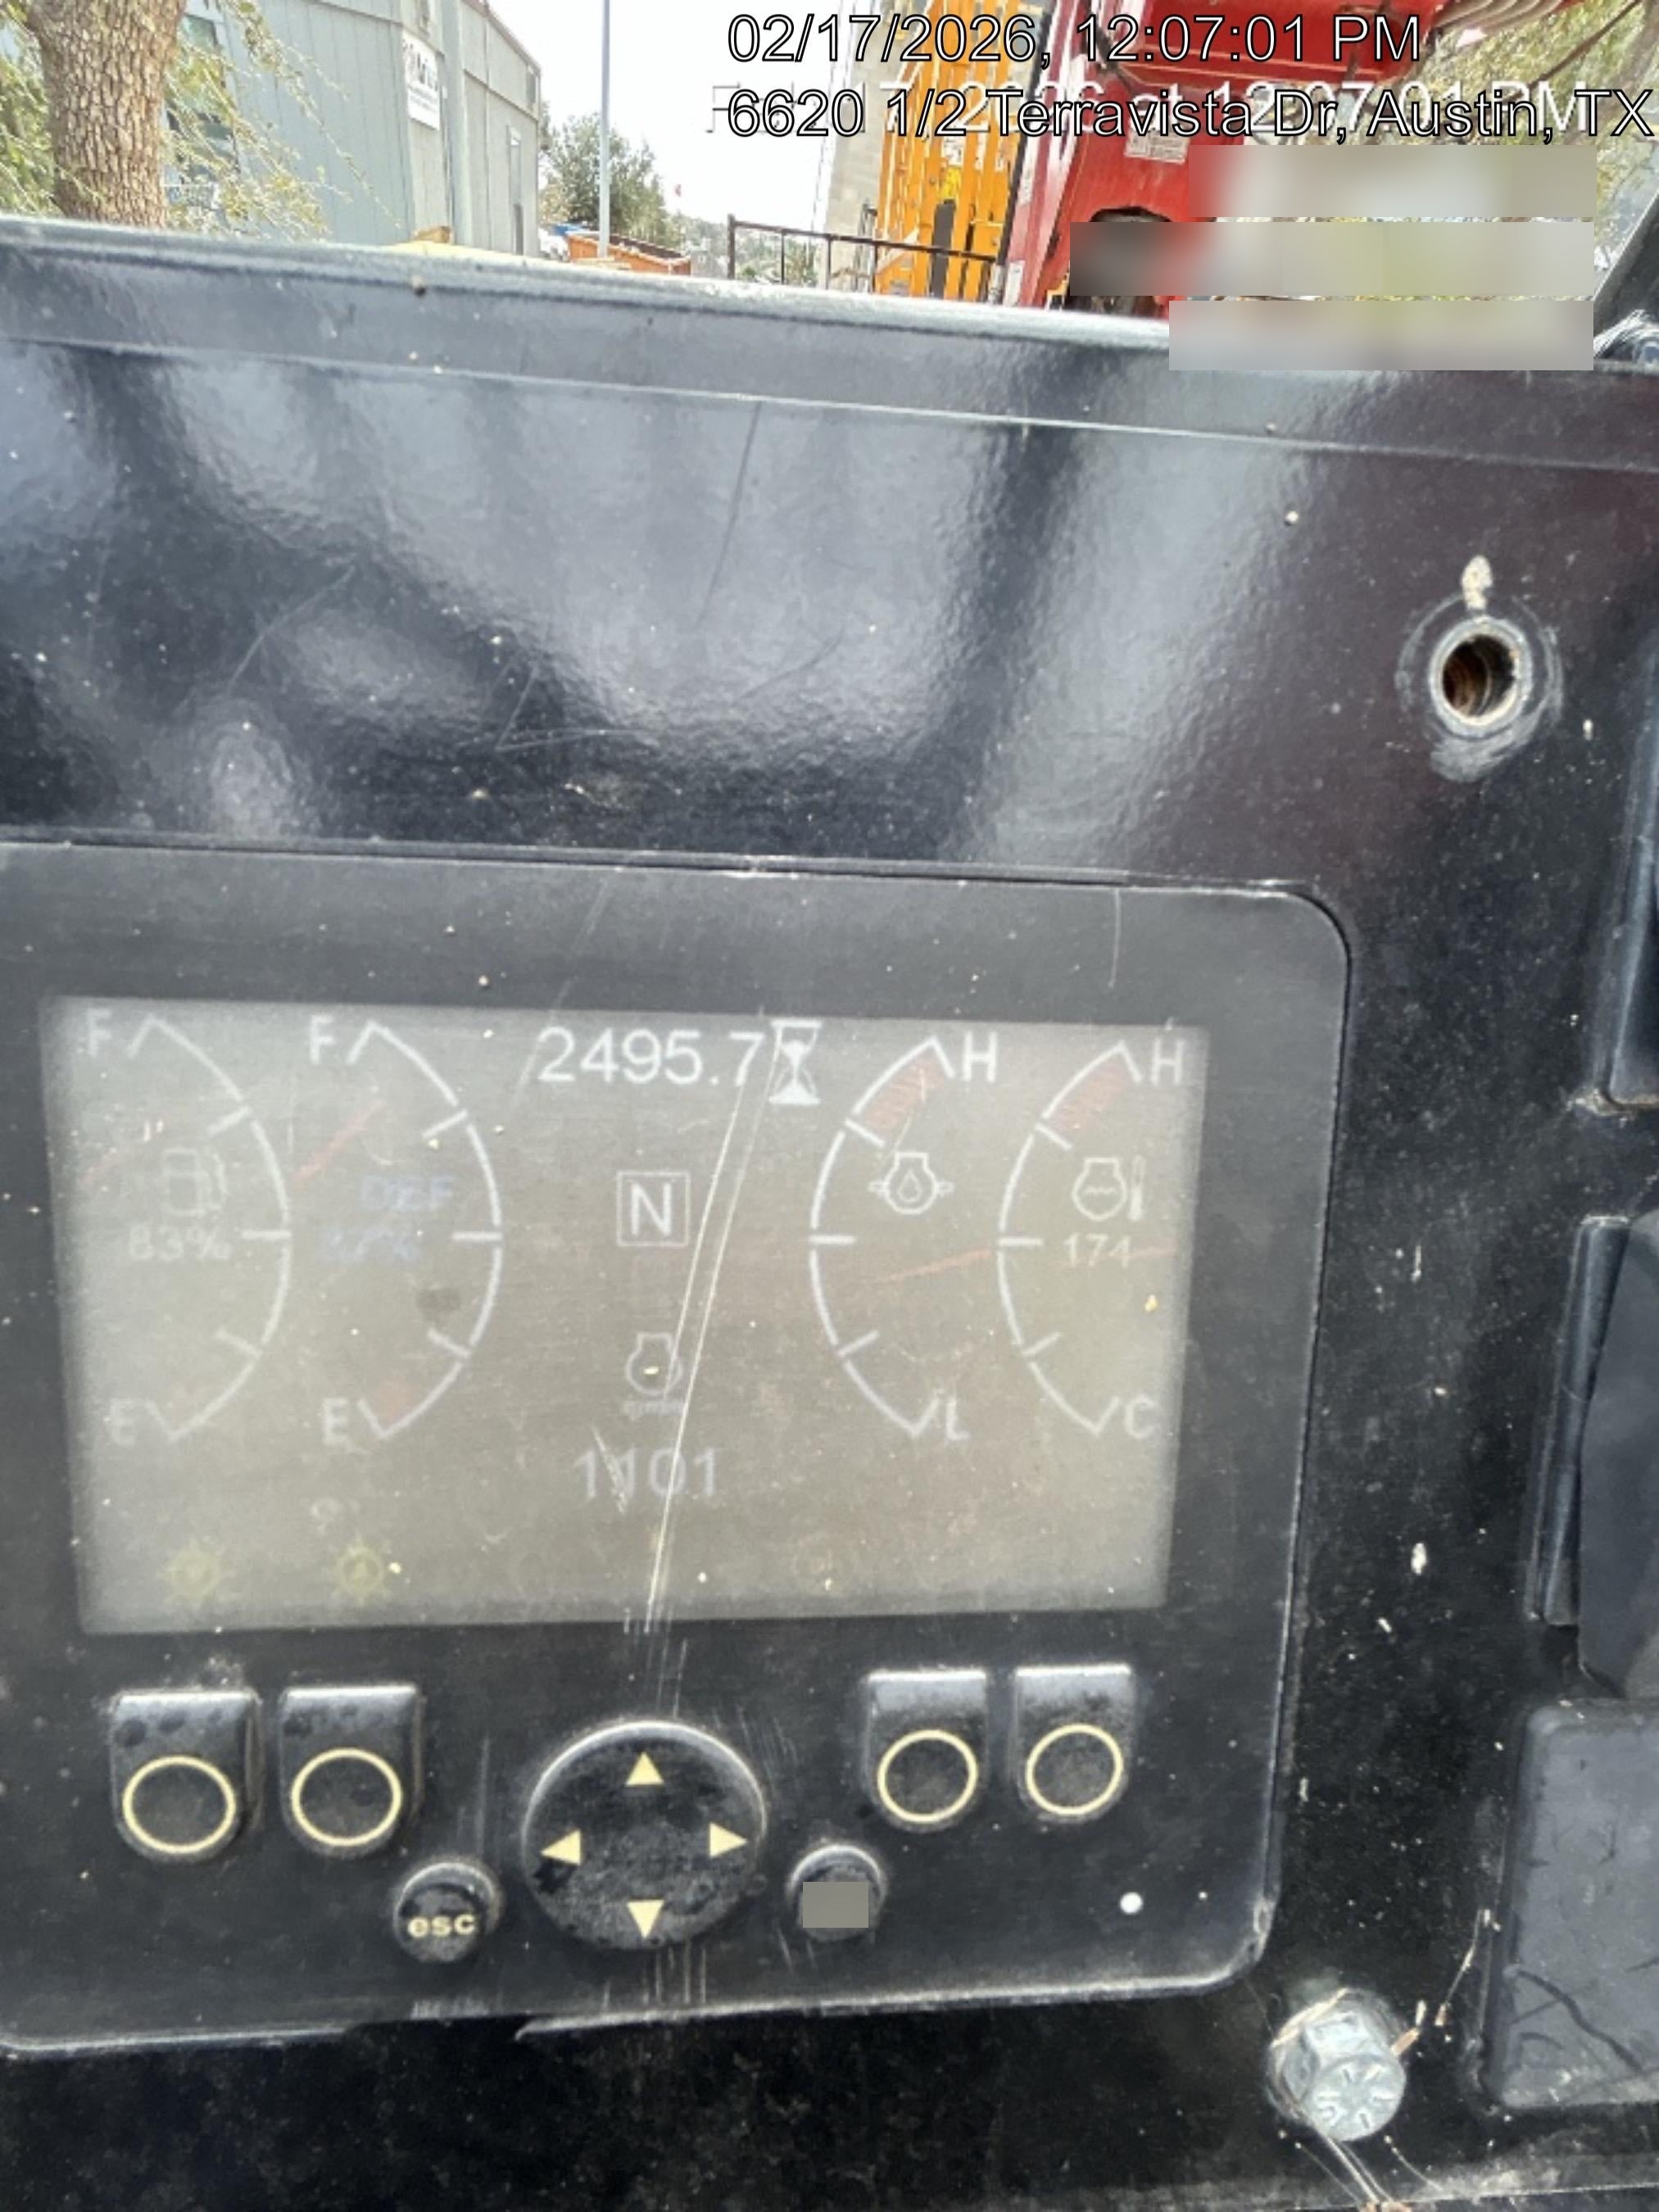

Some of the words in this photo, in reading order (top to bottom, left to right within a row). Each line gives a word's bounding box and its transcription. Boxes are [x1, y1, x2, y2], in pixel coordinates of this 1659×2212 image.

[85, 1009, 112, 1058] F
[309, 1014, 335, 1064] F
[536, 1026, 765, 1087] 2495.7
[962, 1031, 998, 1081] H
[1150, 1037, 1185, 1086] H
[629, 1181, 673, 1237] N
[1063, 1232, 1131, 1268] 174
[321, 1396, 350, 1446] E
[1124, 1394, 1158, 1439] C
[407, 1912, 476, 1939] esc
